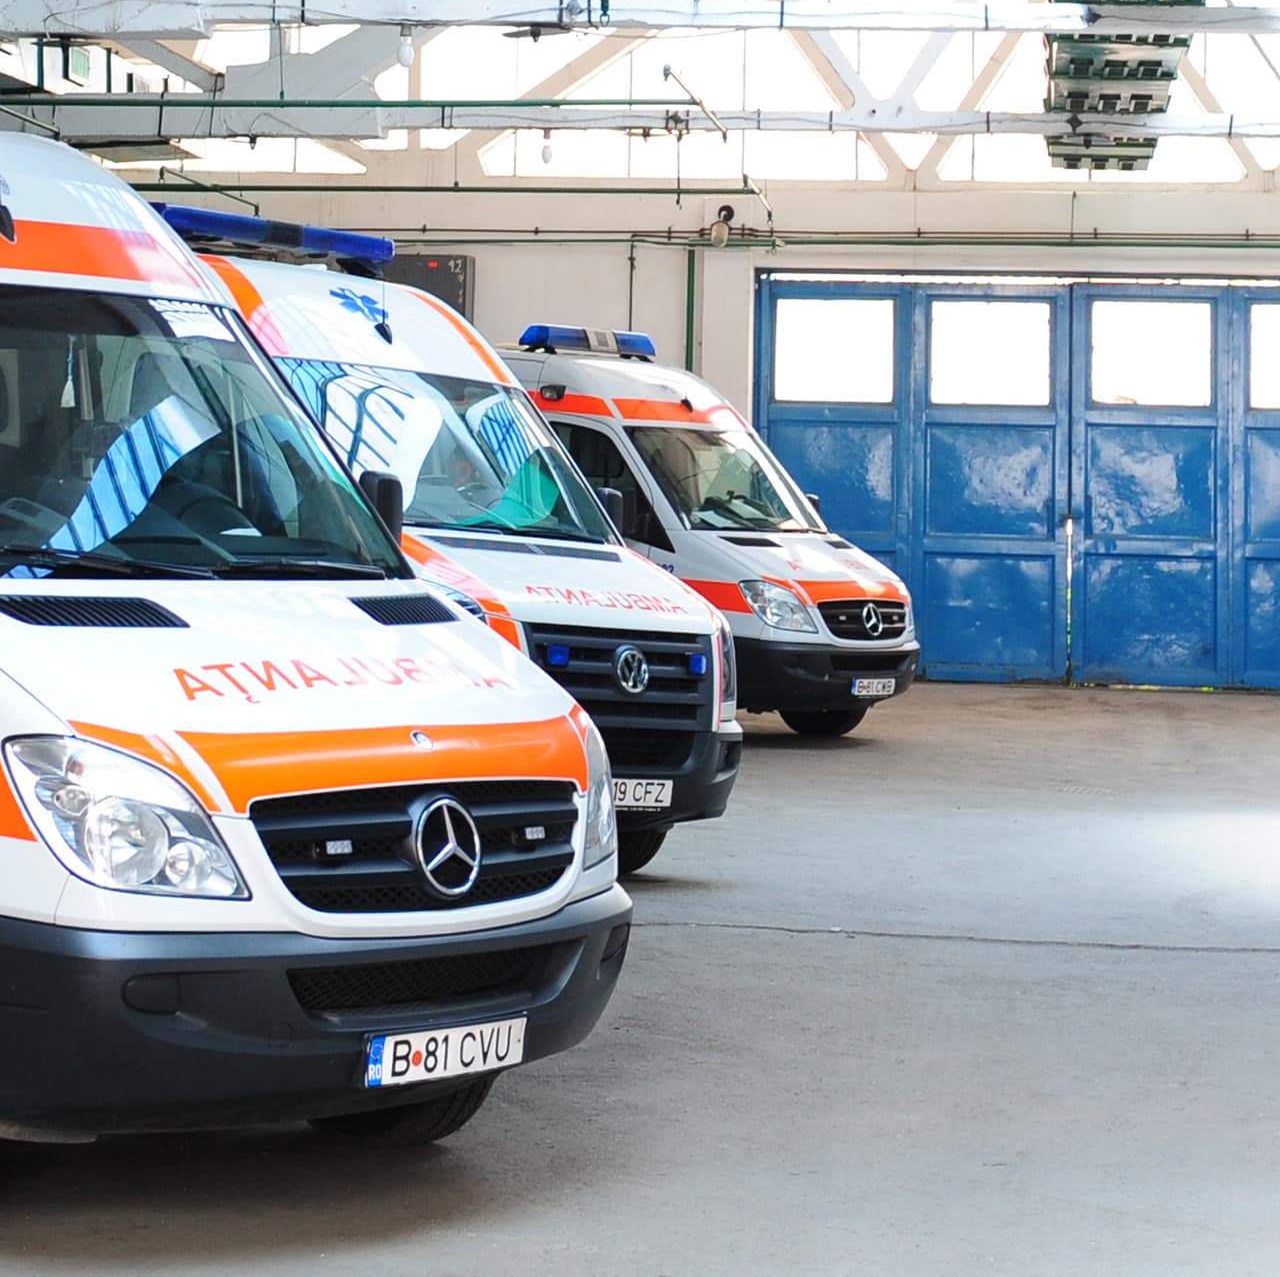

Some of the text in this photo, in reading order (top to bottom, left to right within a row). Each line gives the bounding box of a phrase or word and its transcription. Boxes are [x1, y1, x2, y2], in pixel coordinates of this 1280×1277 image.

[614, 781, 666, 803] 19 CFZ
[391, 1024, 513, 1078] B 81 CVU
[369, 1063, 382, 1081] RO
